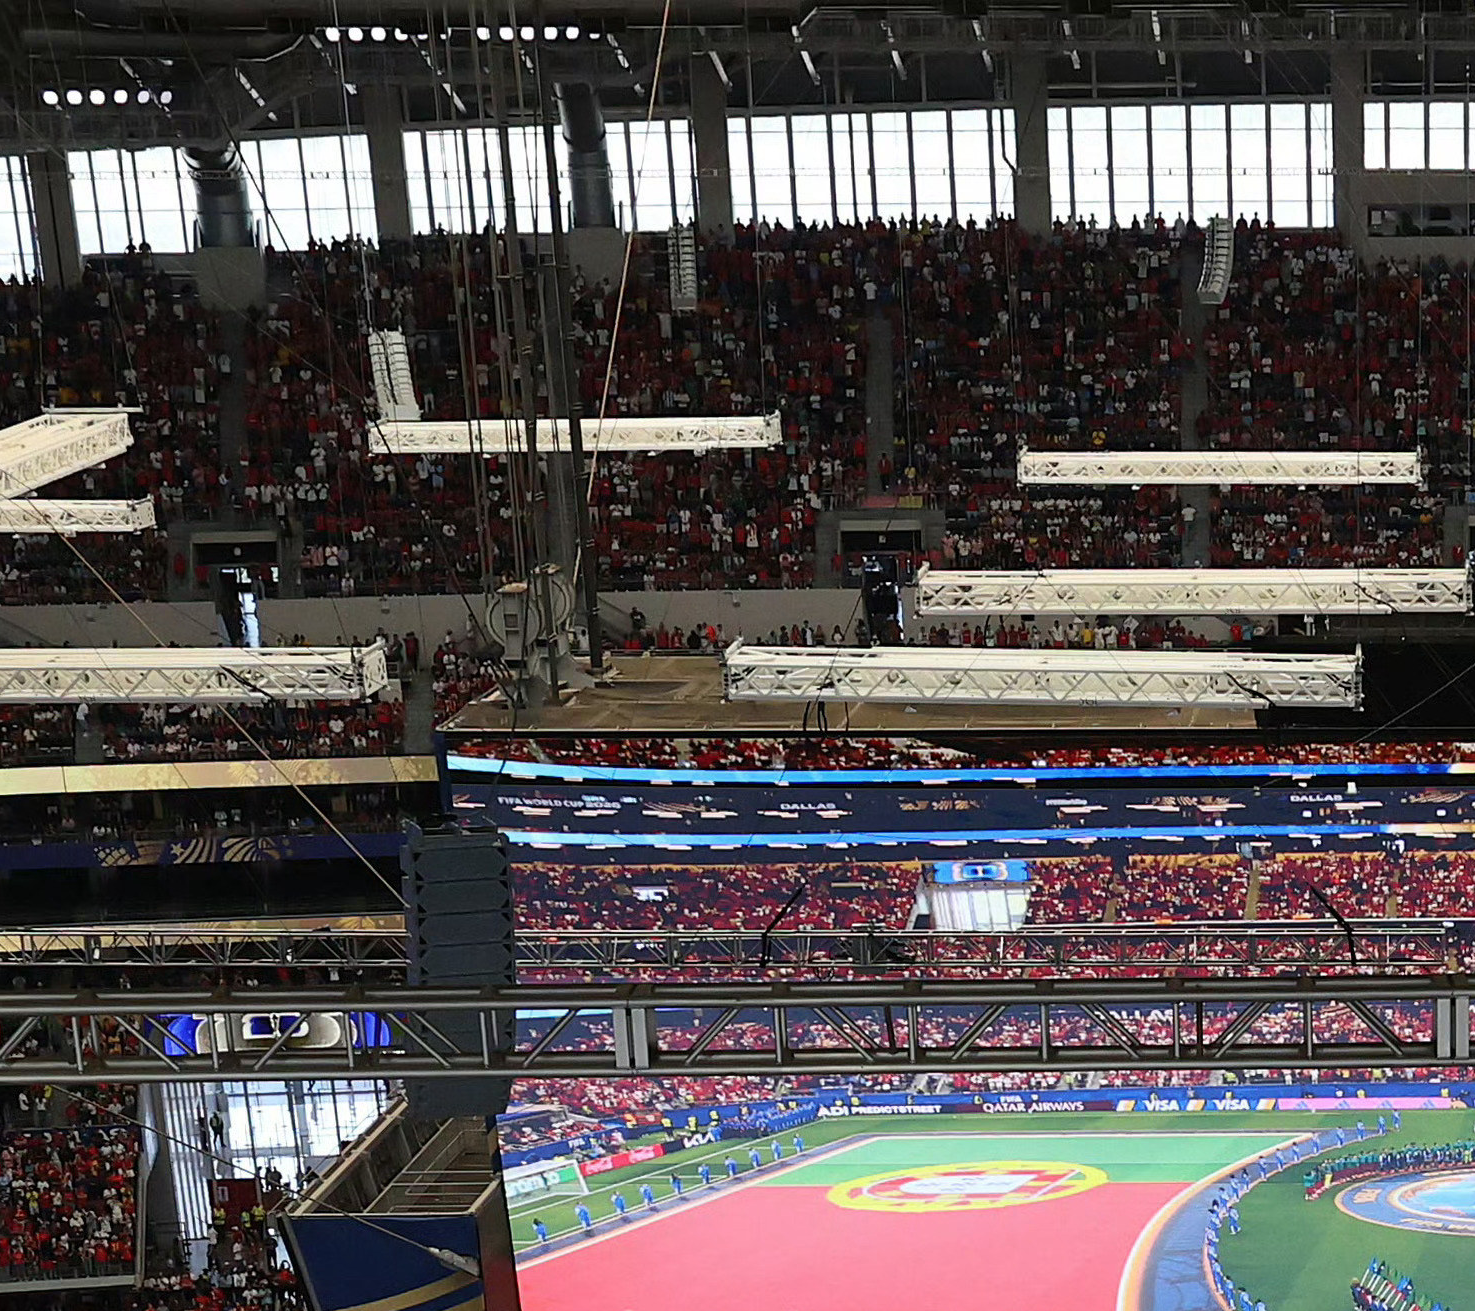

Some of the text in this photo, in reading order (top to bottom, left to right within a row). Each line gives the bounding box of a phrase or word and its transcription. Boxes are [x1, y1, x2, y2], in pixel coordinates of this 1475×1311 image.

[983, 1101, 1085, 1113] QATAR AIRWAYS
[1143, 1099, 1179, 1111] VISA
[1214, 1098, 1250, 1111] VISA
